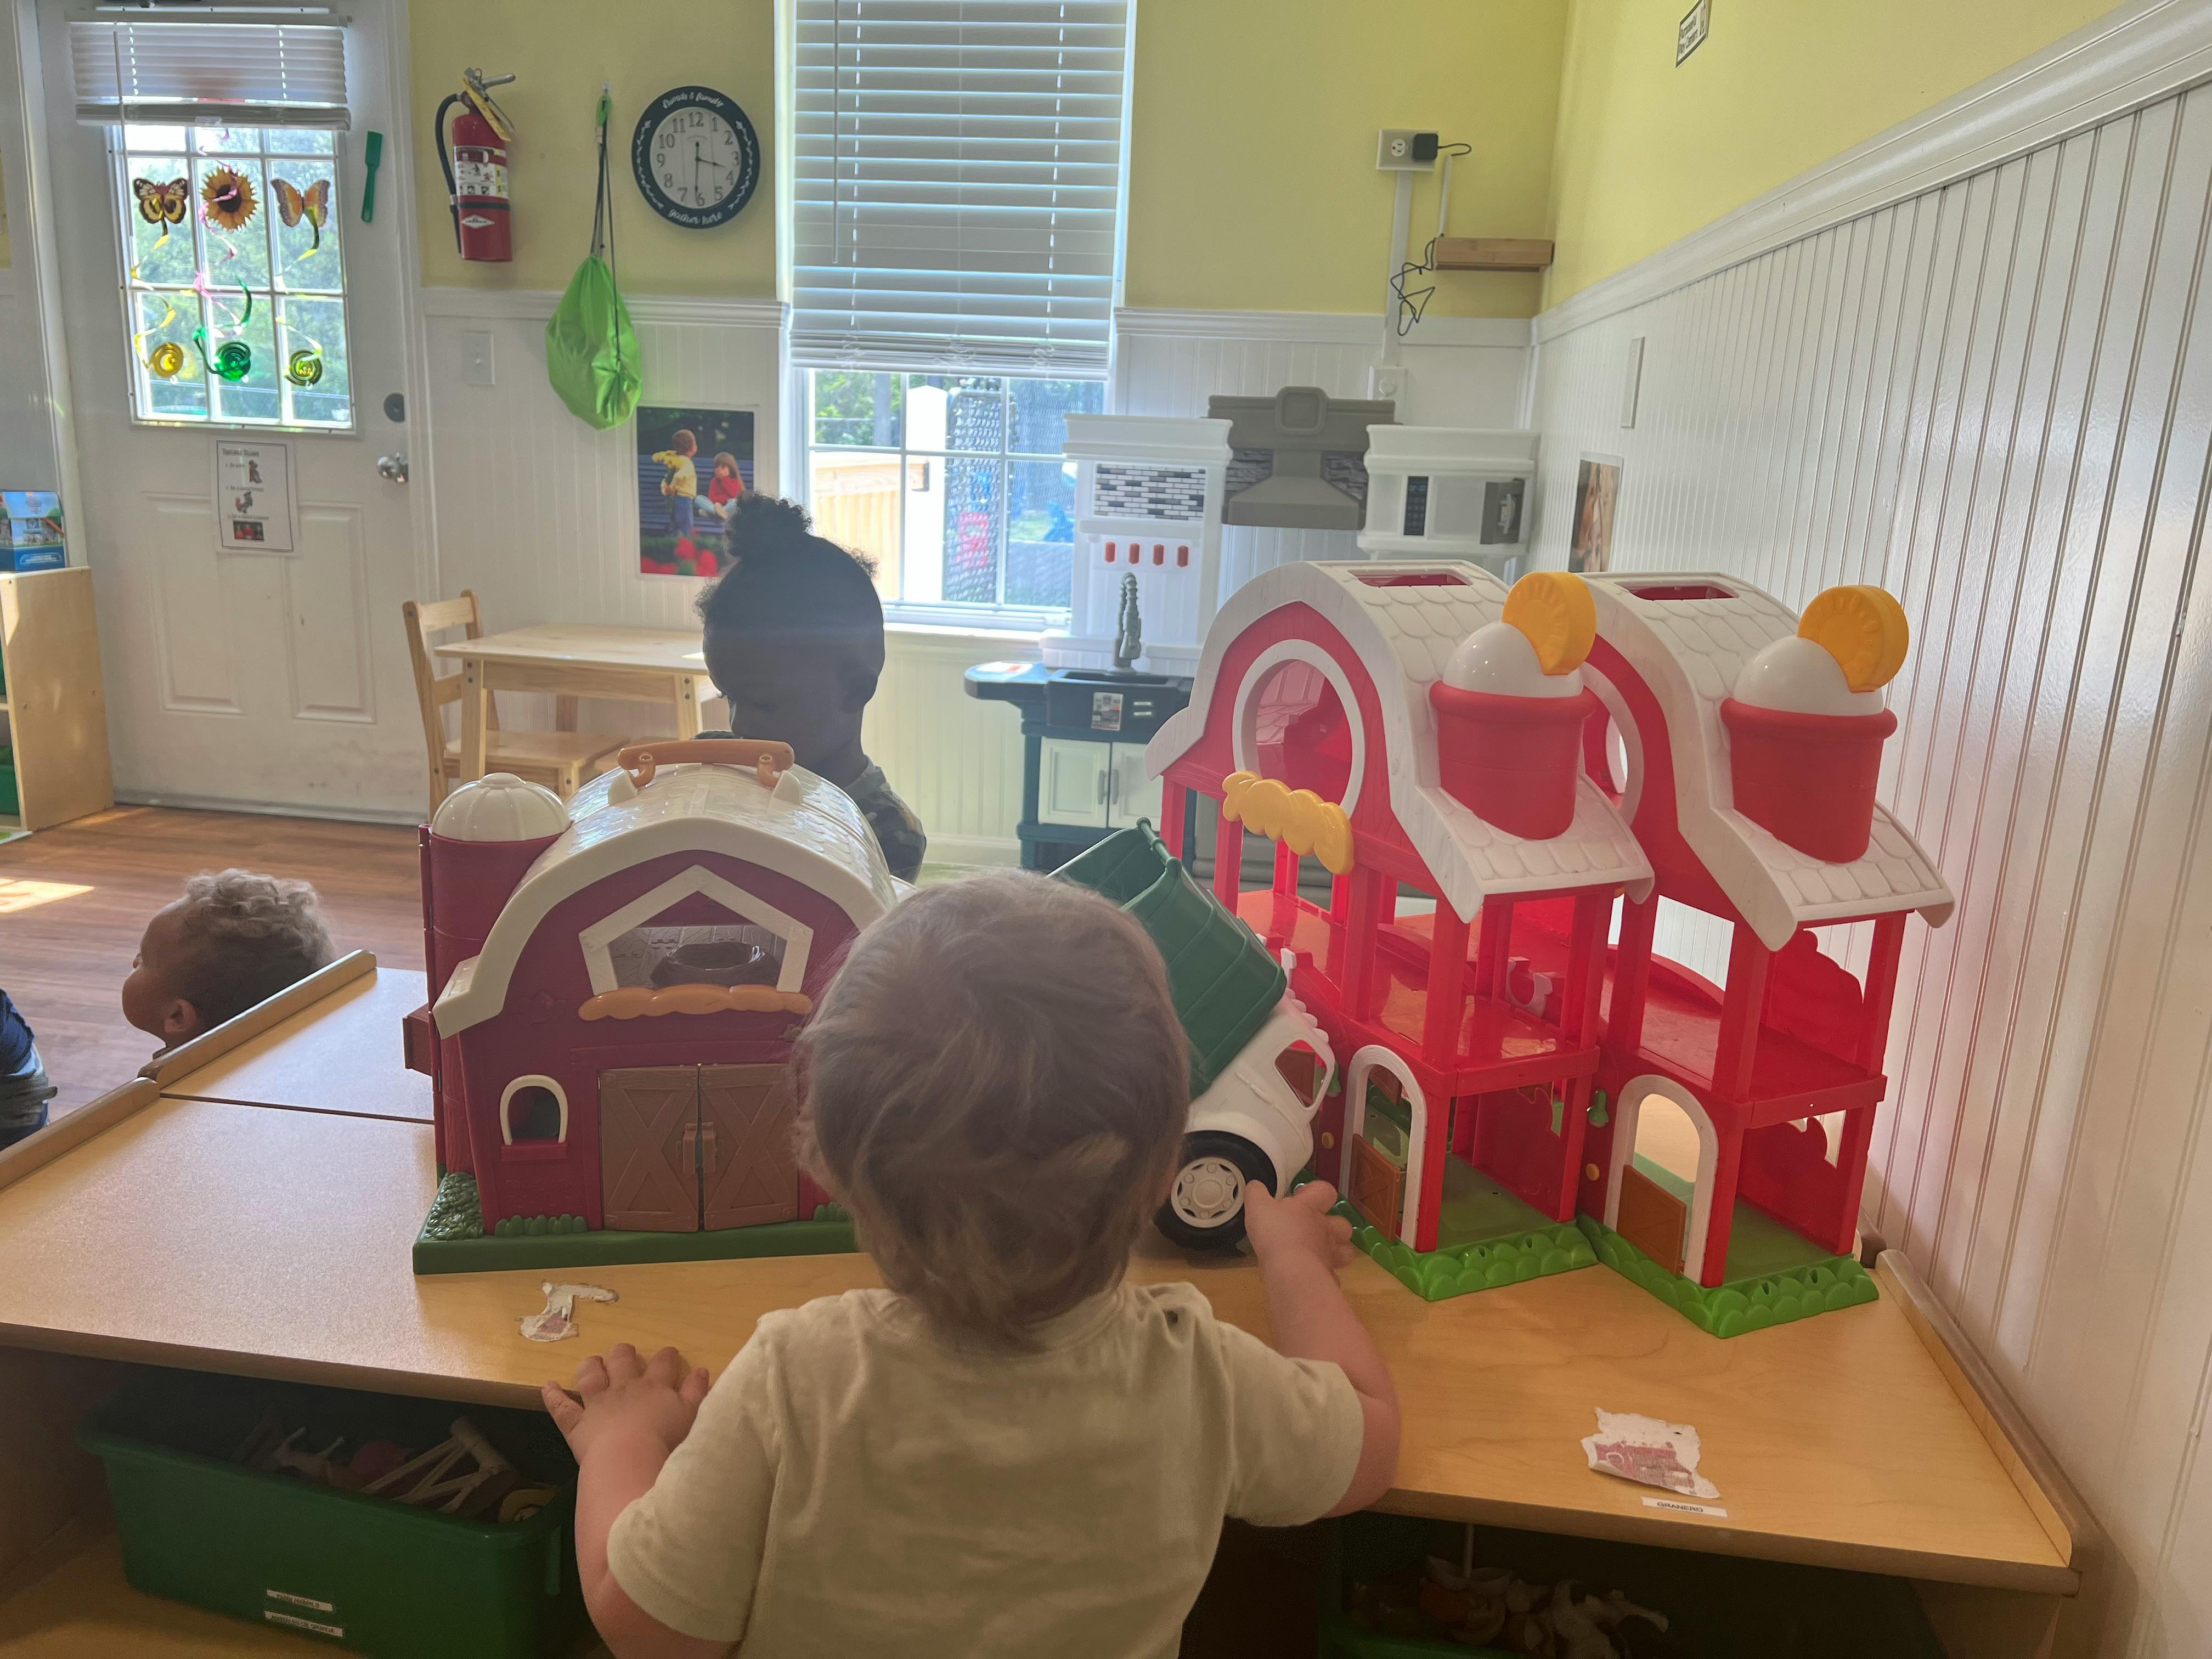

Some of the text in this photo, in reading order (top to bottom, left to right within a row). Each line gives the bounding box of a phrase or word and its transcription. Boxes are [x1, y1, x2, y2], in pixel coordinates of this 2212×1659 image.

[695, 92, 724, 108] family
[672, 117, 686, 133] 11
[689, 111, 704, 127] 12
[711, 117, 718, 132] 1
[658, 133, 675, 149] 10
[724, 130, 733, 145] 2
[656, 153, 665, 168] 9
[731, 151, 740, 166] 3
[664, 173, 673, 188] 8
[725, 170, 734, 185] 4
[678, 187, 687, 202] 7
[697, 193, 705, 206] 6
[714, 185, 724, 201] 5
[668, 208, 723, 225] gather here
[1657, 1501, 1703, 1513] GRANERO
